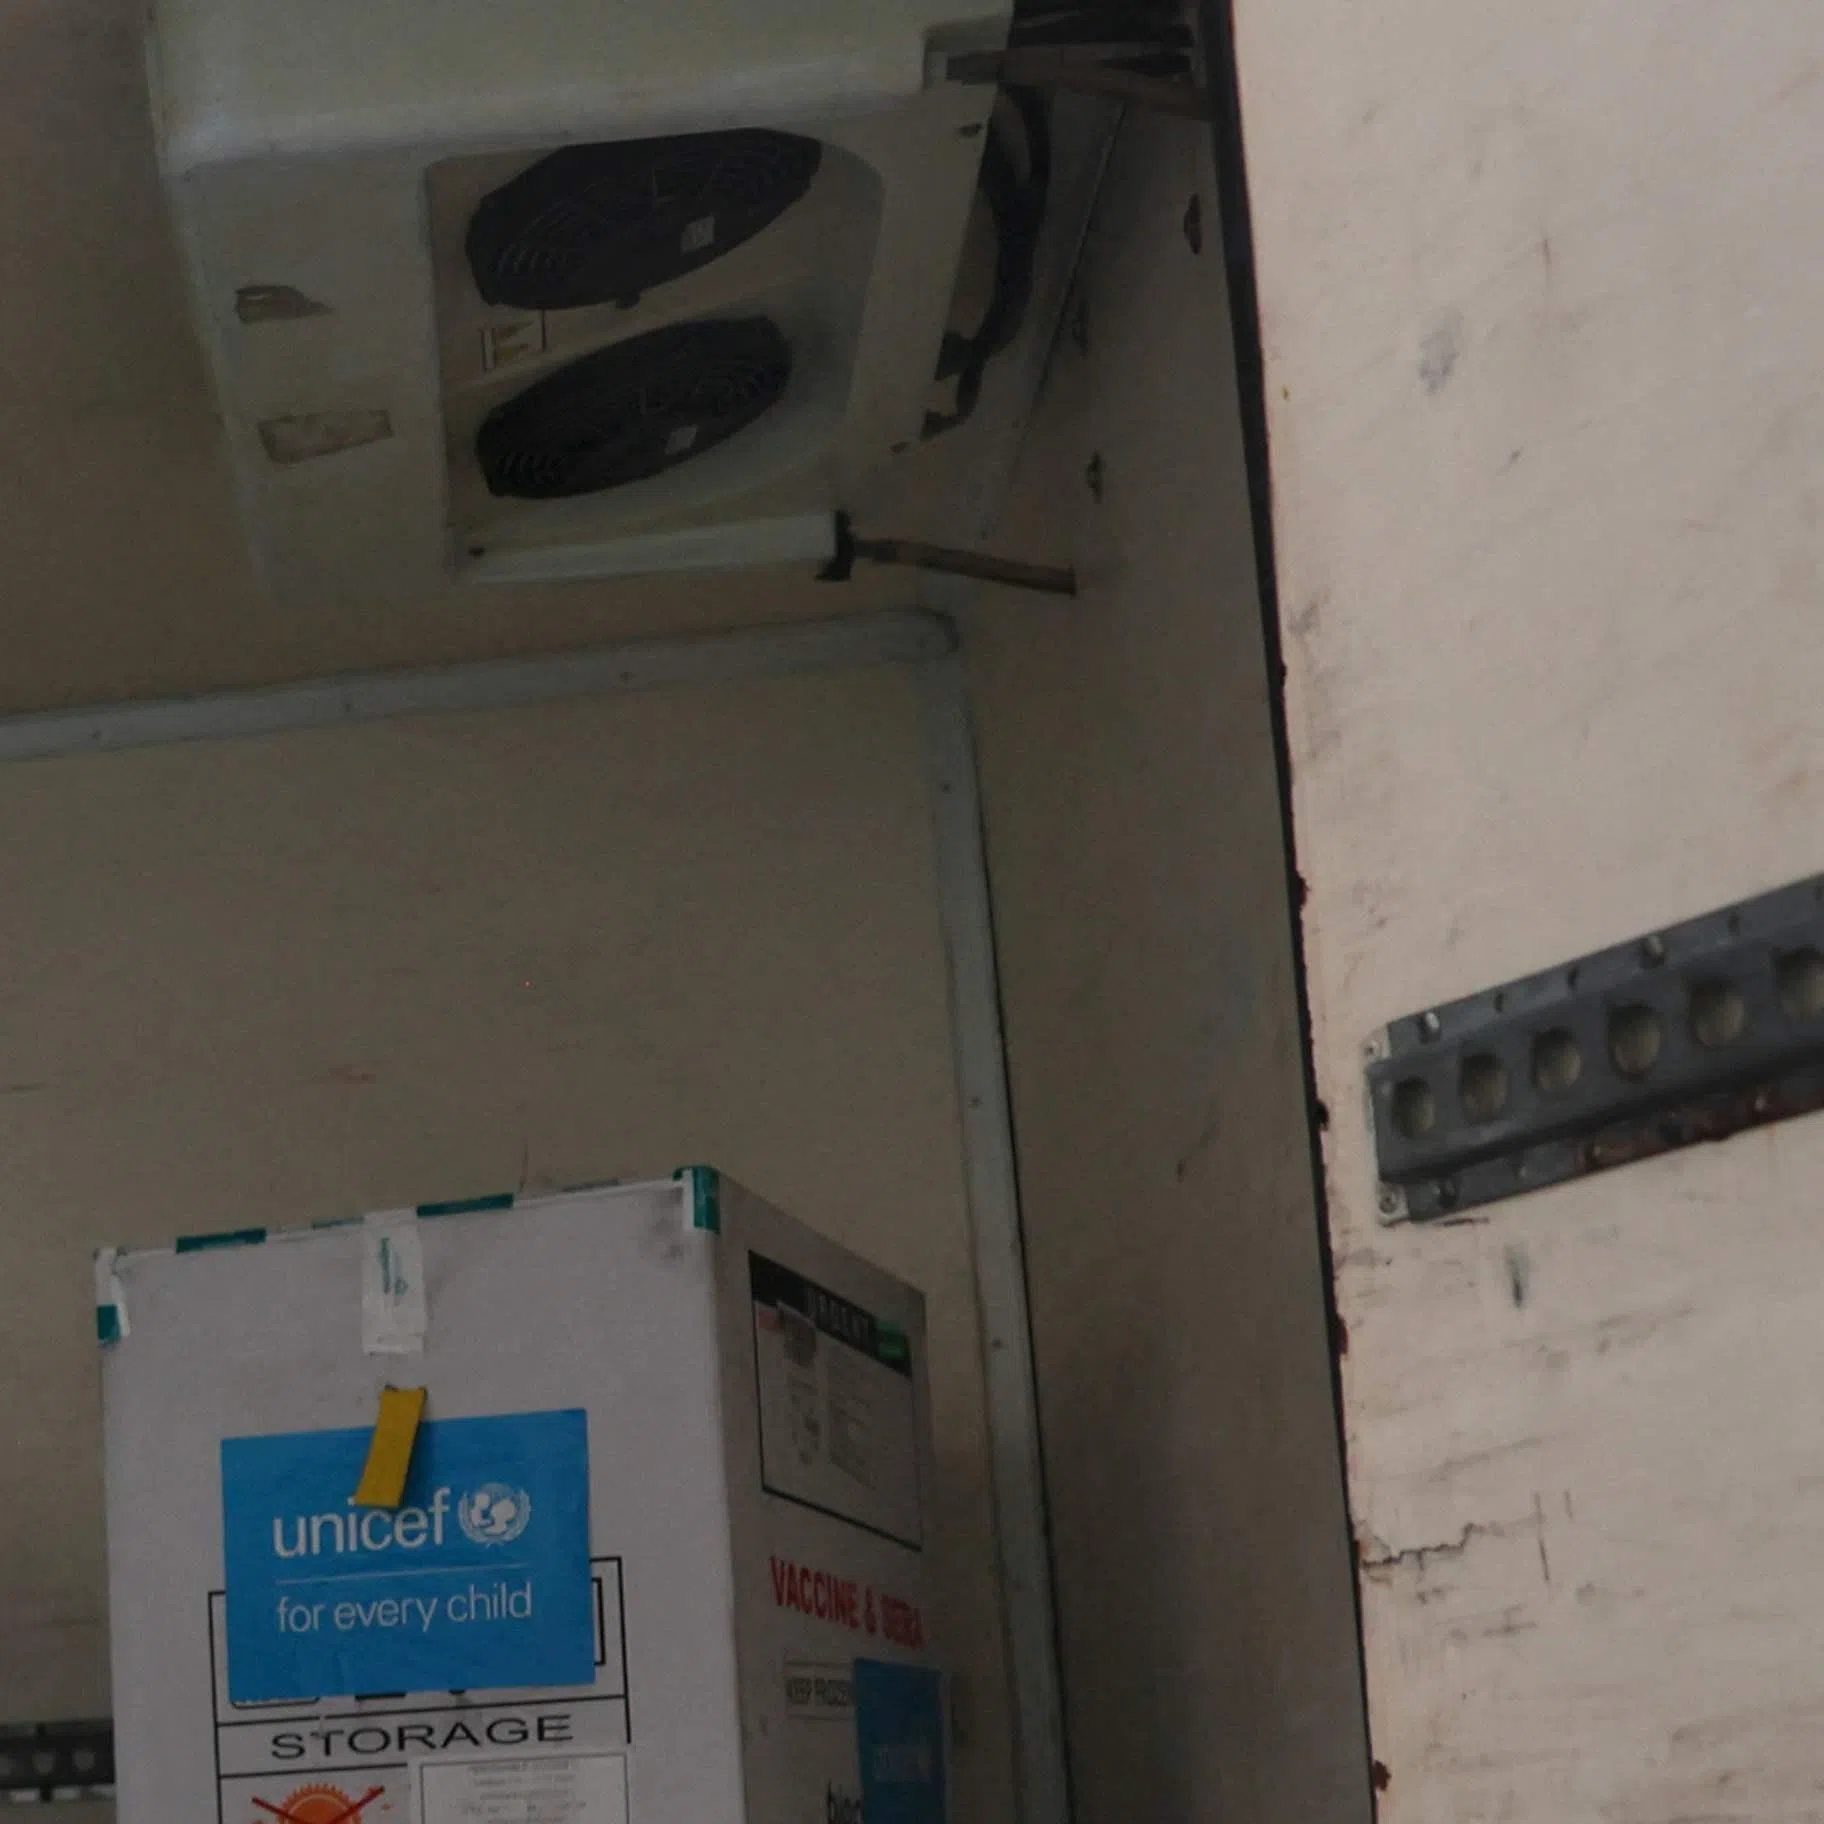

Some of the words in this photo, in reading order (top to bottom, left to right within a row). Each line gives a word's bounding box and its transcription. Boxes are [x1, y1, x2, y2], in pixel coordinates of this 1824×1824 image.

[273, 1487, 452, 1560] unicef
[277, 1594, 322, 1634] for
[333, 1589, 435, 1635] every
[446, 1583, 533, 1622] child
[770, 1557, 861, 1630] VACCINE
[269, 1714, 574, 1762] STORAGE
